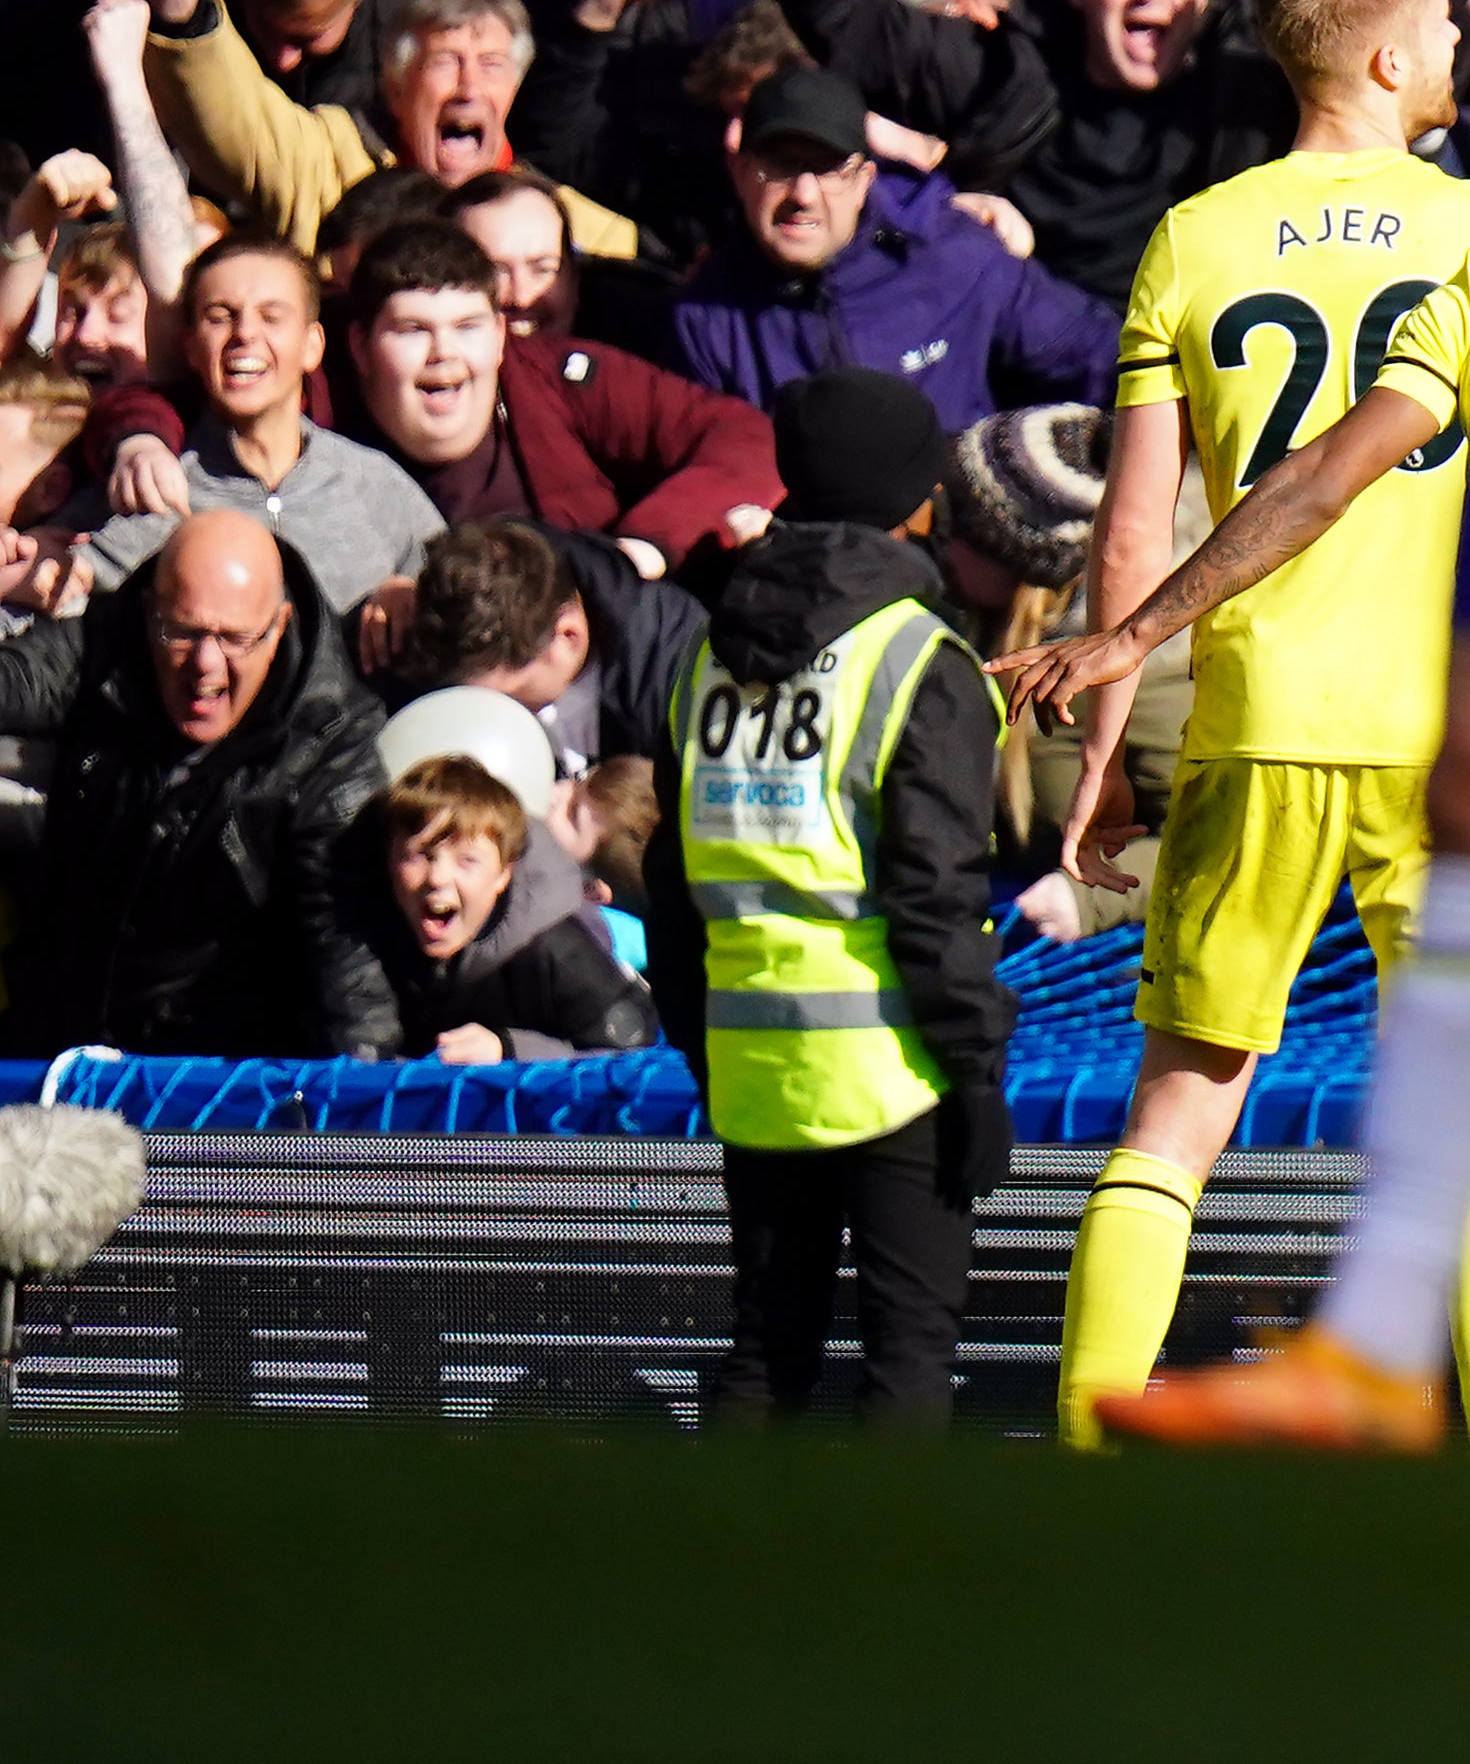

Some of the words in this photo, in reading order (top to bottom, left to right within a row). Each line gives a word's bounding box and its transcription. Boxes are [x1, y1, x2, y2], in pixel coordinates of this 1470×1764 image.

[1277, 208, 1401, 256] AJER
[701, 686, 822, 761] 018
[706, 781, 806, 806] servoca
